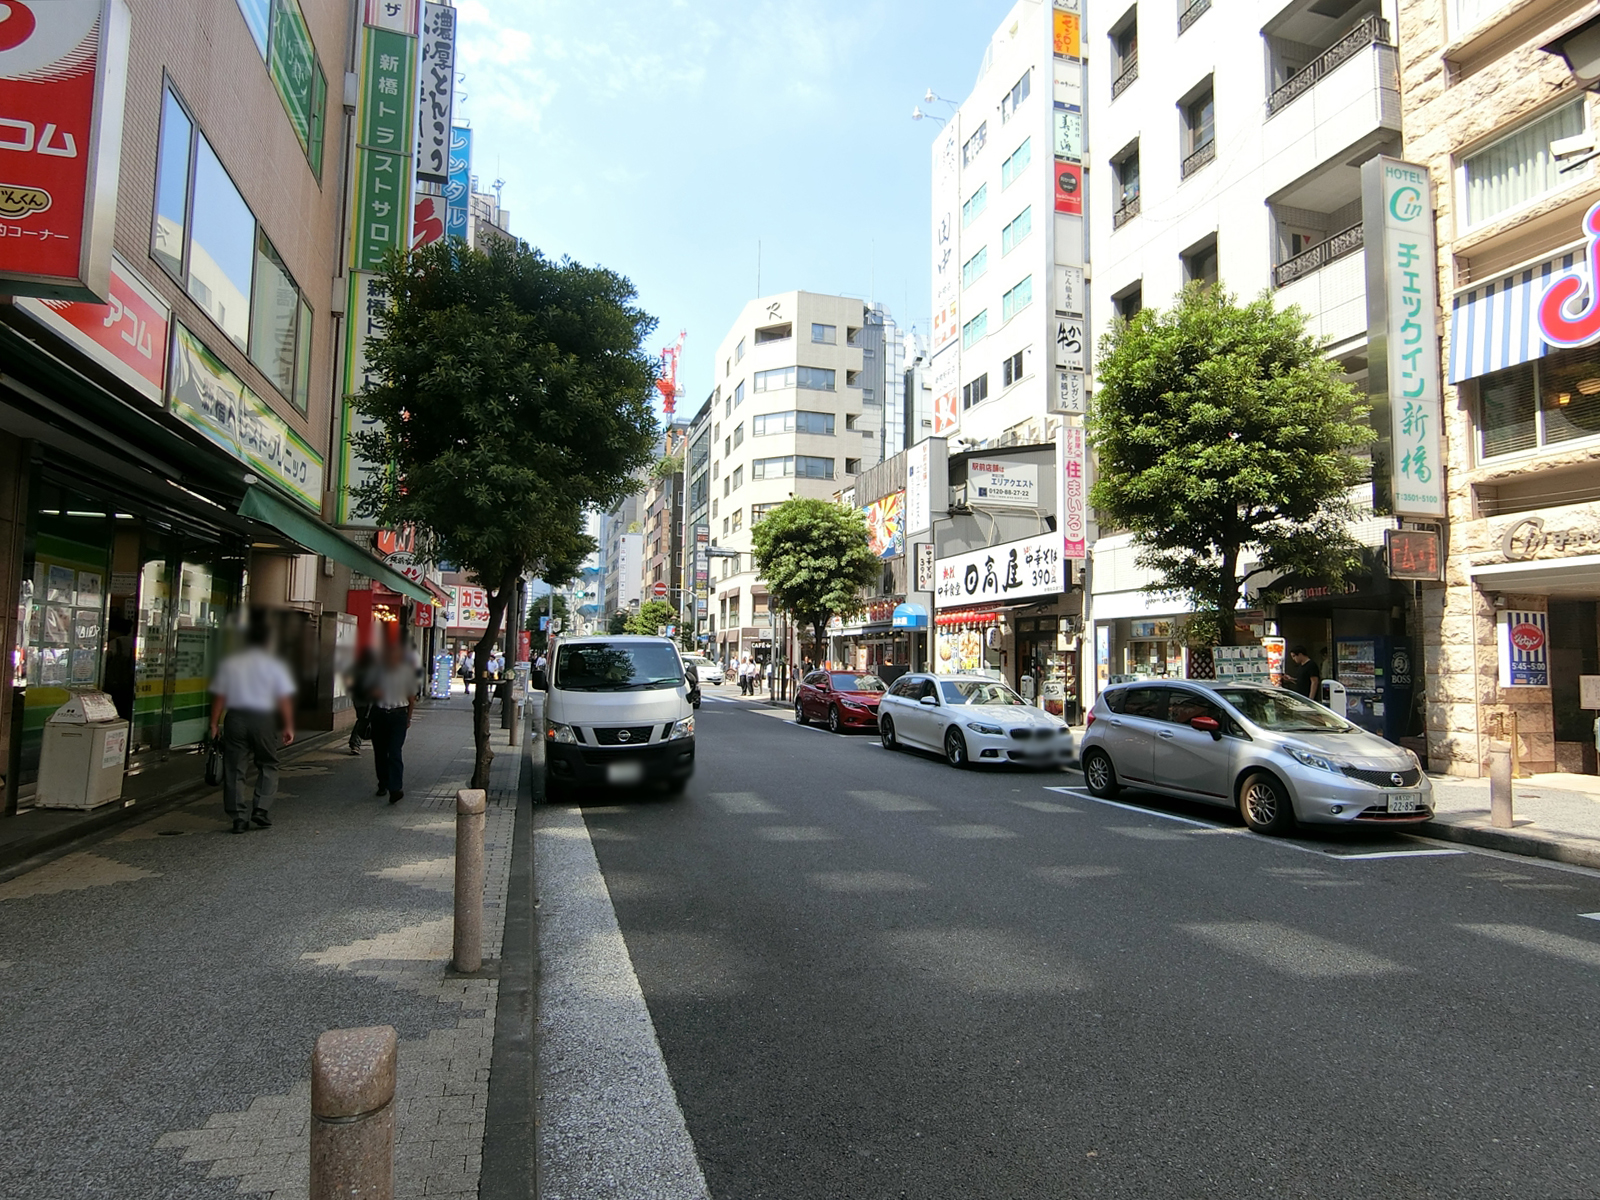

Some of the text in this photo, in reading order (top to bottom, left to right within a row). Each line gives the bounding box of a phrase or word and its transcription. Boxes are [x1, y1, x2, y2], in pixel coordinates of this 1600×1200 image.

[429, 9, 454, 172] 濃厚とんこつ
[1385, 166, 1423, 184] HOTEL
[103, 294, 152, 359] アコム
[1060, 374, 1069, 409] 新橋ビル
[1071, 375, 1079, 410] エレガンス
[972, 462, 1005, 472] 駅前店舗は
[988, 487, 1029, 497] 0120-88-27-22
[991, 478, 1034, 488] エリアクエスト
[1066, 461, 1081, 531] 住まいる
[1025, 545, 1058, 568] 中華そば
[964, 548, 1023, 595] 日高屋
[938, 581, 961, 598] 中華食堂
[1391, 675, 1411, 684] BOSS
